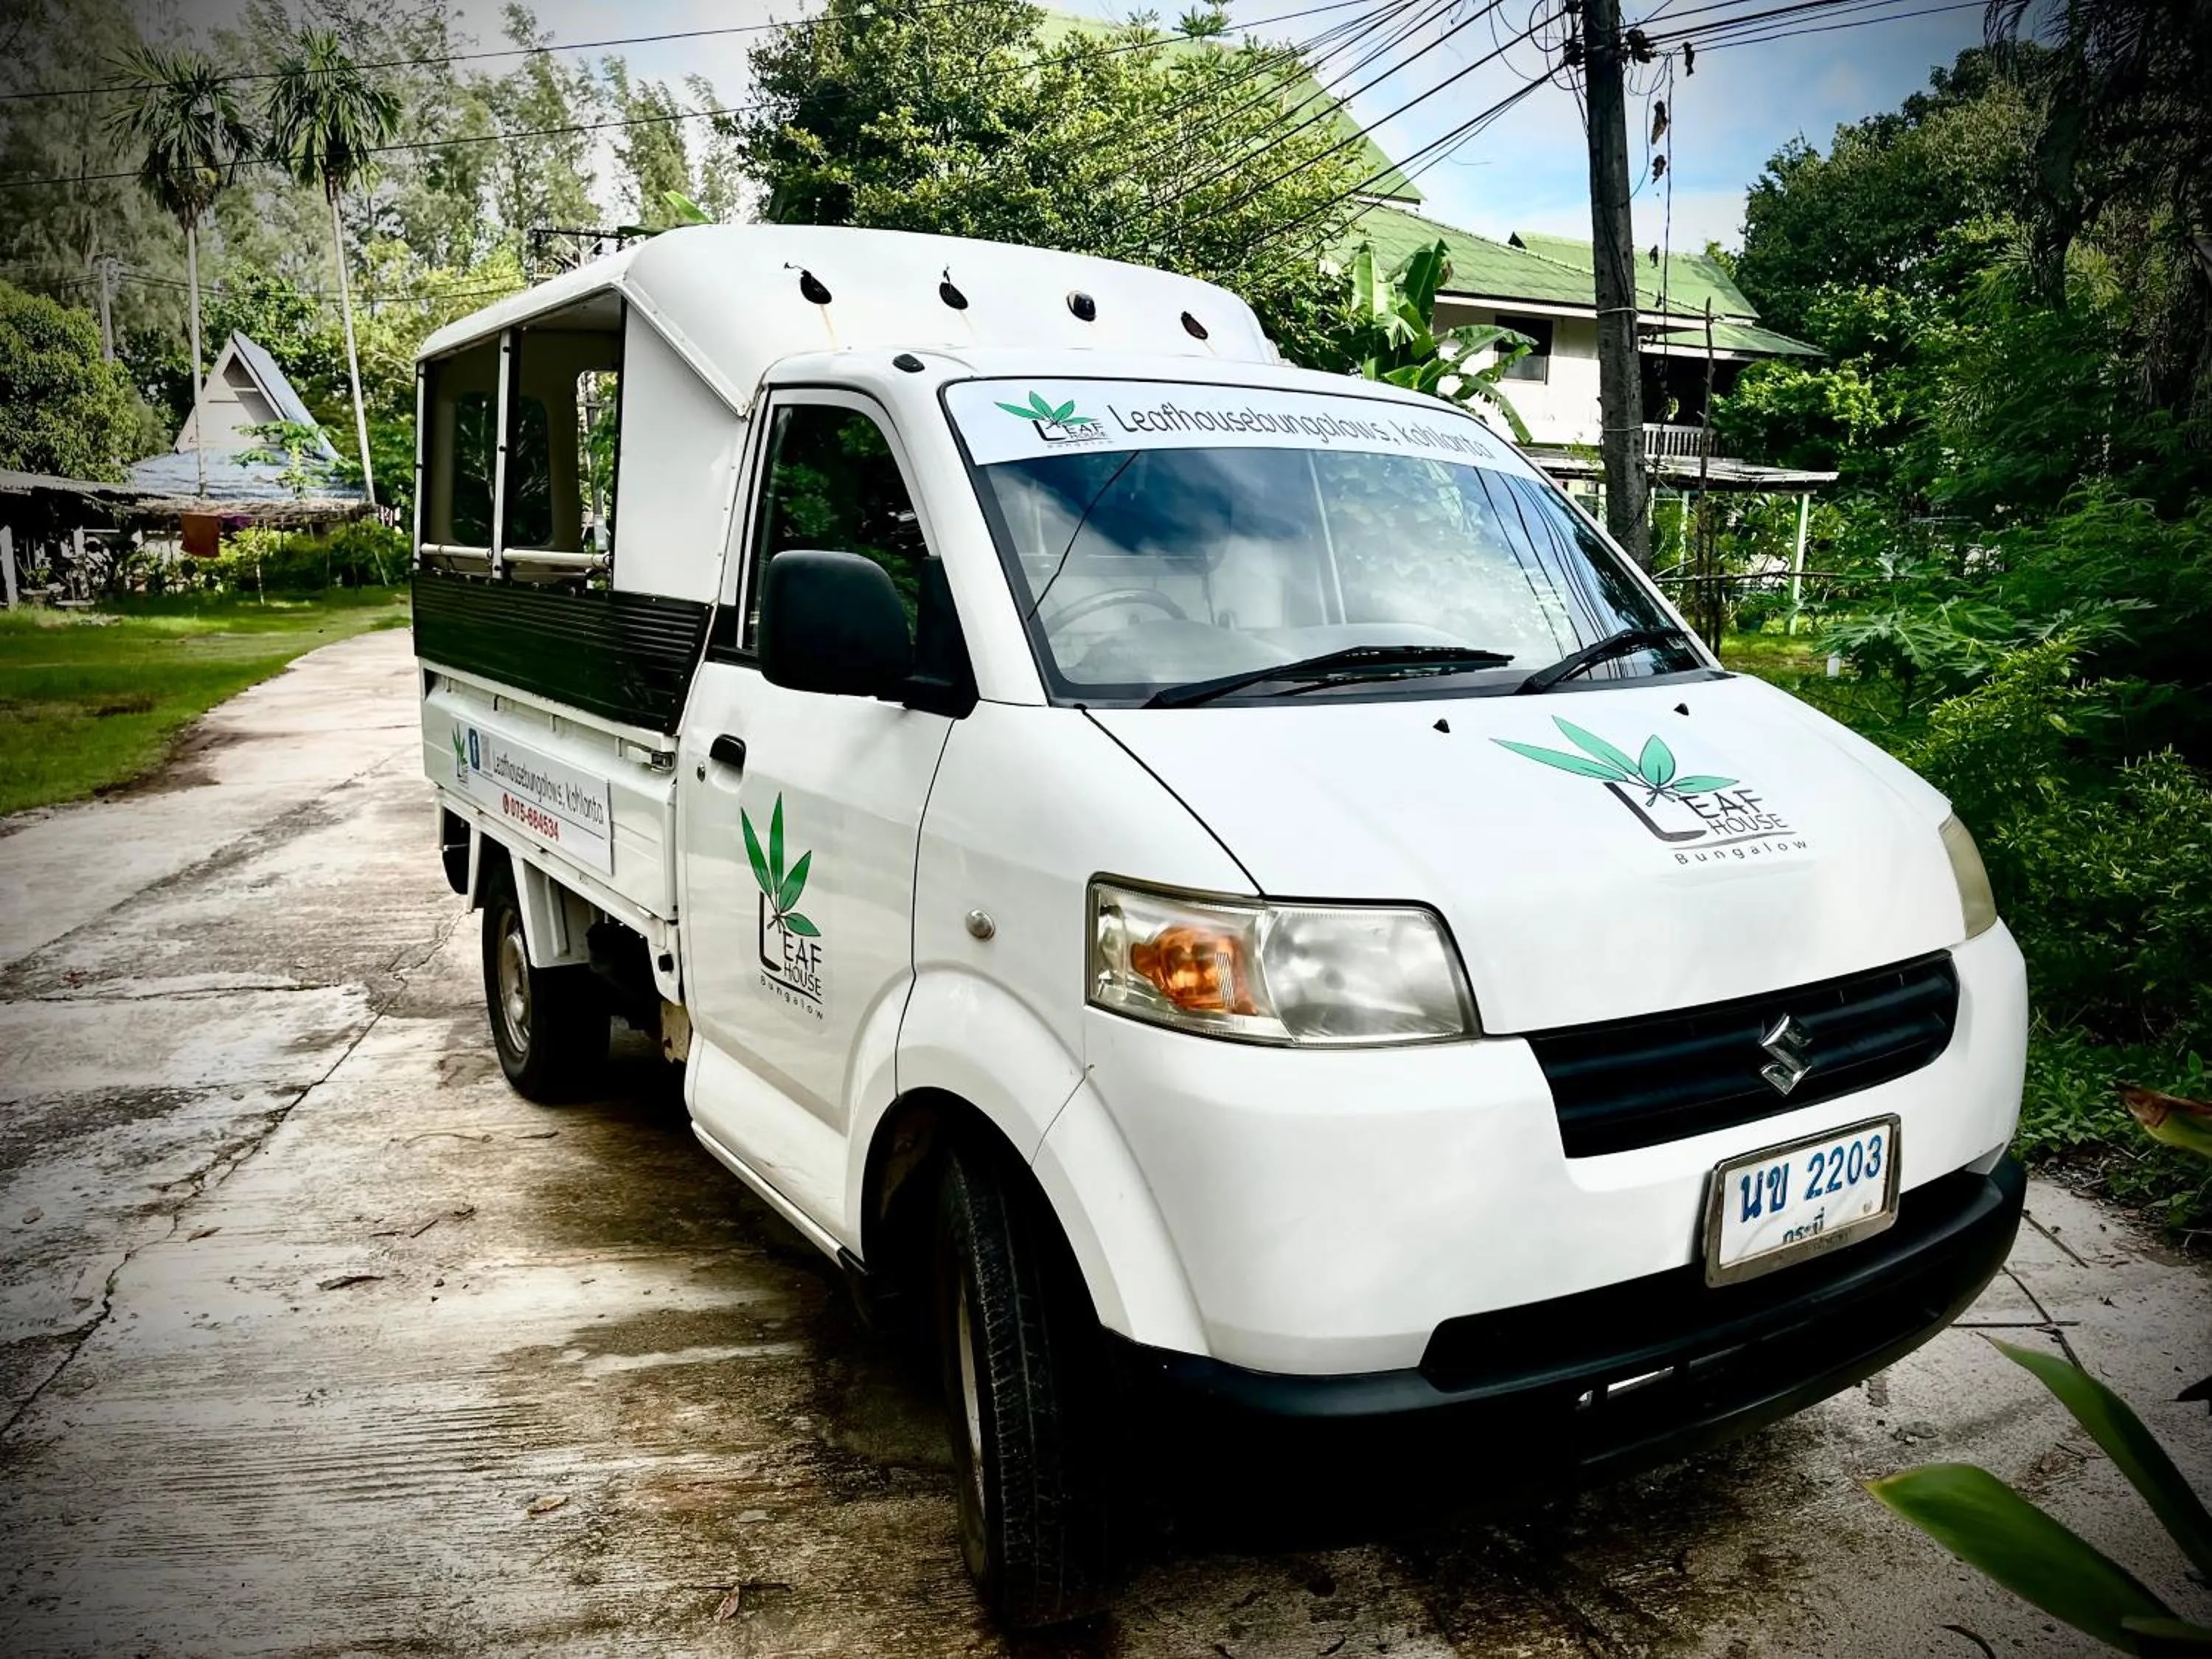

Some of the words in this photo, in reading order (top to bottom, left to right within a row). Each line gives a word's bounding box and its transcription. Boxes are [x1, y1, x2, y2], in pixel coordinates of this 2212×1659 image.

[1603, 782, 1762, 842] LEAF
[1706, 813, 1788, 835] HOUSE
[1674, 840, 1808, 865] Bungalow
[759, 891, 822, 973] LEAF
[760, 975, 824, 1020] Bungalow
[784, 961, 821, 996] HOUSE
[1804, 1135, 1882, 1200] 2203
